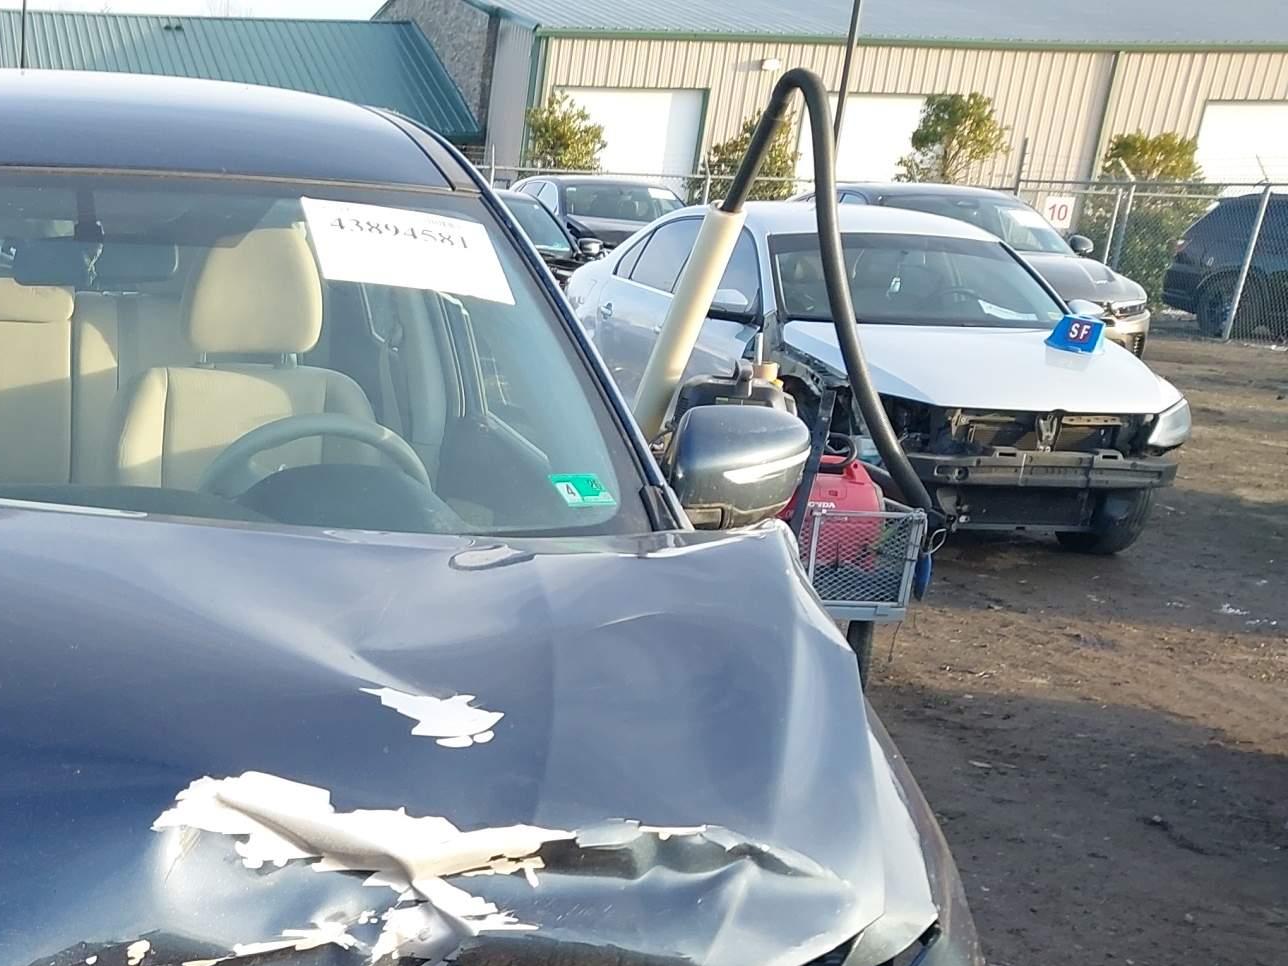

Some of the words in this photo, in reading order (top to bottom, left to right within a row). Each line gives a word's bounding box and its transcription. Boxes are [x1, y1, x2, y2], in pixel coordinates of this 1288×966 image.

[1048, 203, 1069, 221] 10
[330, 217, 468, 249] 43894581
[1069, 322, 1092, 340] SF
